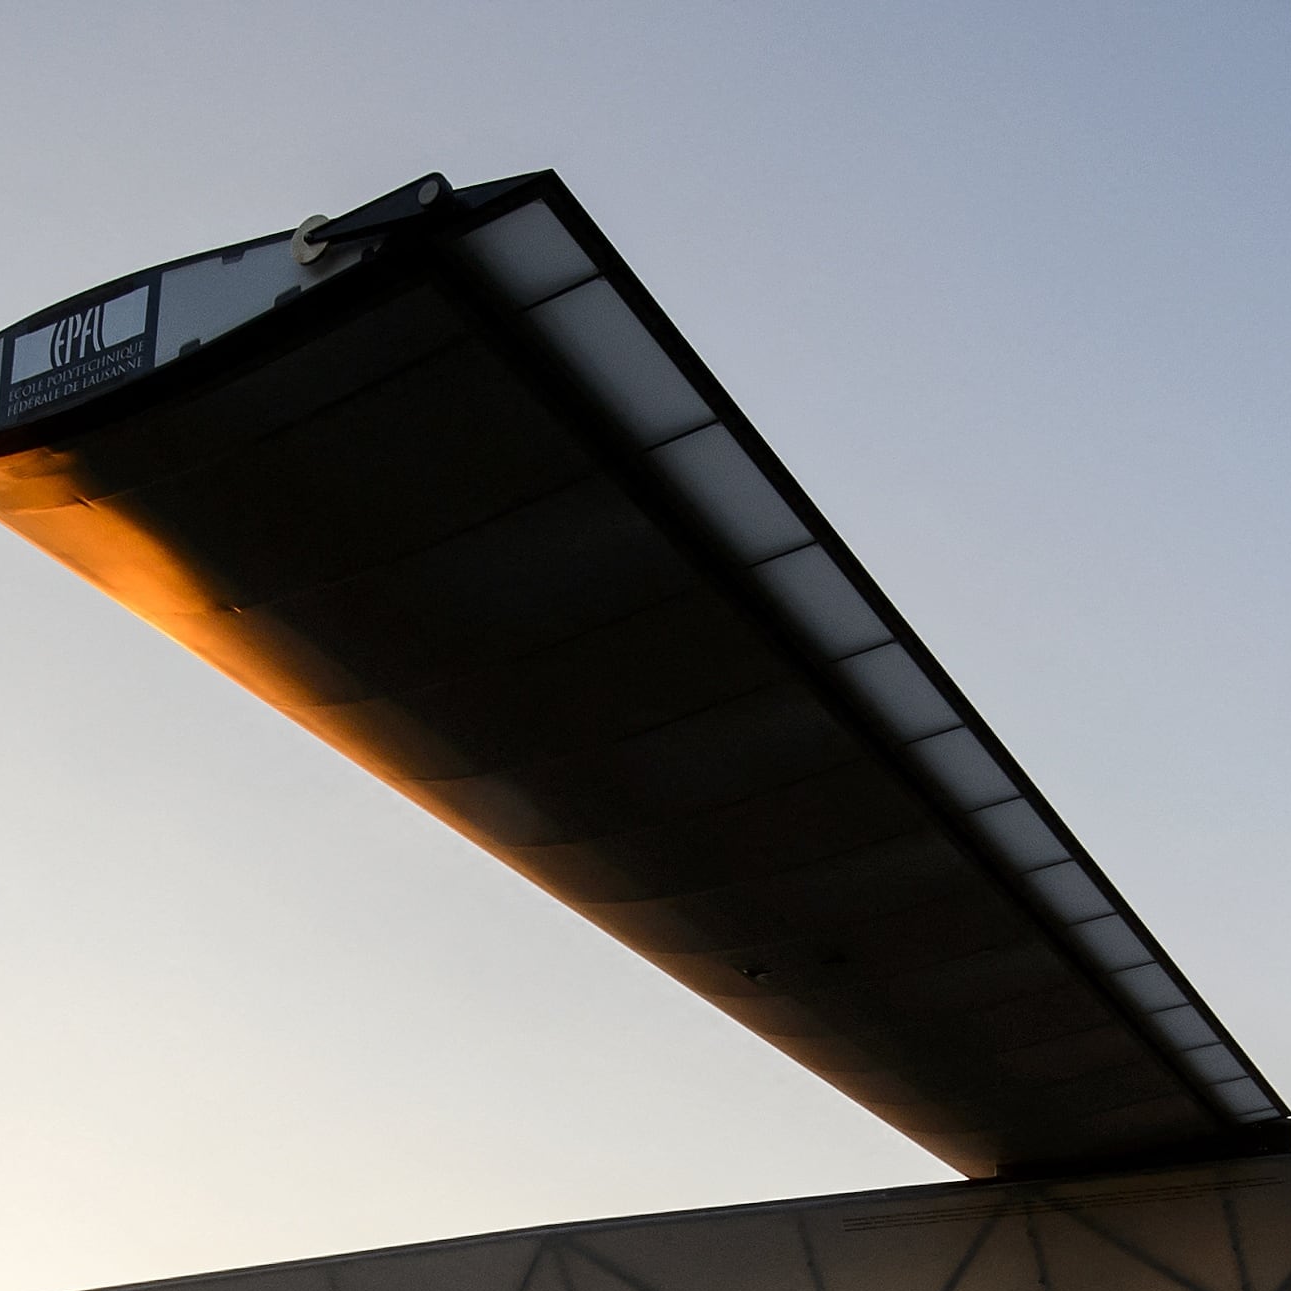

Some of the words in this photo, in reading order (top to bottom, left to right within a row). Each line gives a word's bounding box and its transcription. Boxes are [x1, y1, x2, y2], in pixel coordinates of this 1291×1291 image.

[54, 305, 101, 367] EPFL
[47, 340, 145, 388] POLYTECHNIQUE
[63, 381, 78, 396] DE
[82, 357, 143, 389] LAUSANNE
